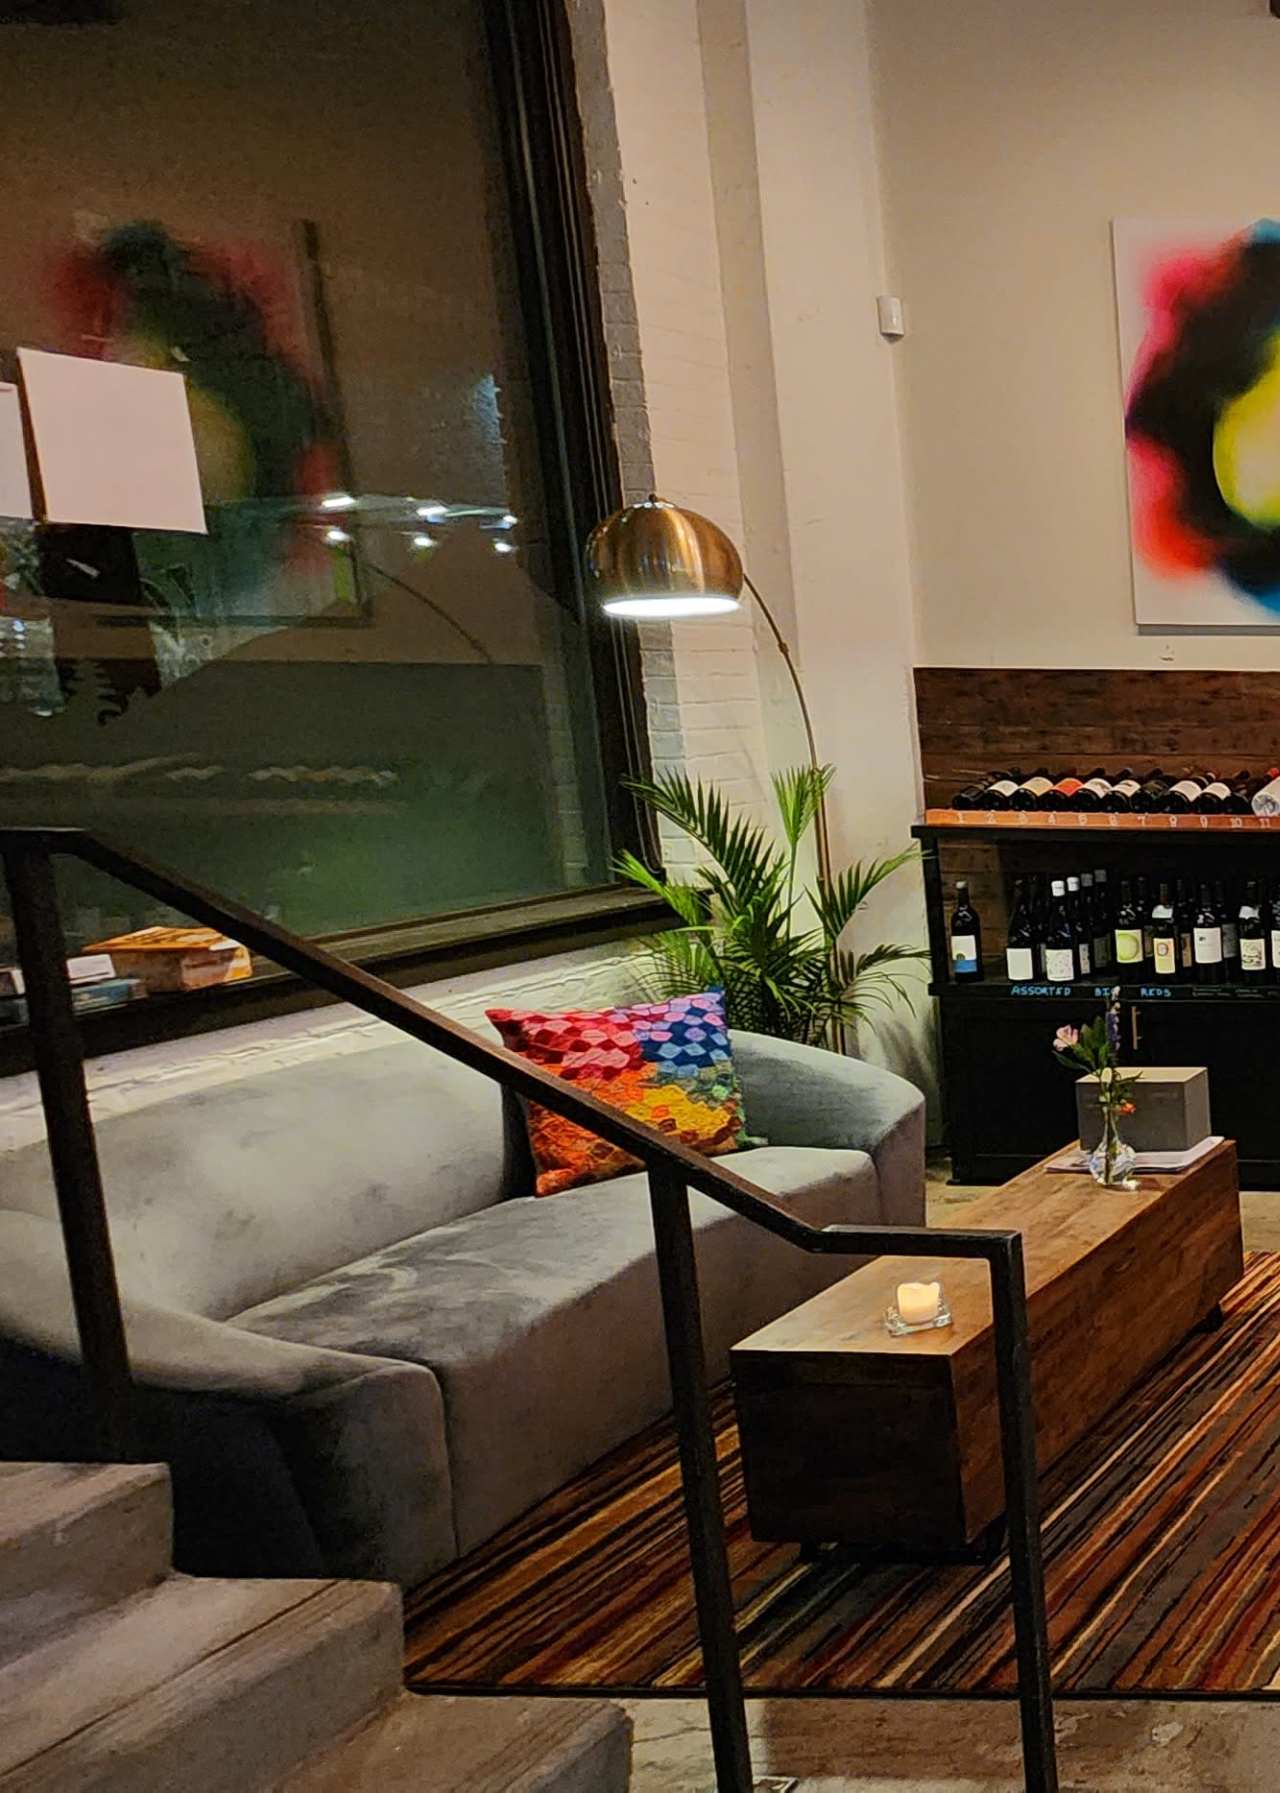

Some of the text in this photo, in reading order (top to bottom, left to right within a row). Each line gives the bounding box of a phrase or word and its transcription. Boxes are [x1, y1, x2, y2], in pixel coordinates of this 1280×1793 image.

[1137, 815, 1146, 826] 7
[1011, 986, 1071, 997] ASSORTED
[1140, 988, 1172, 998] REDS
